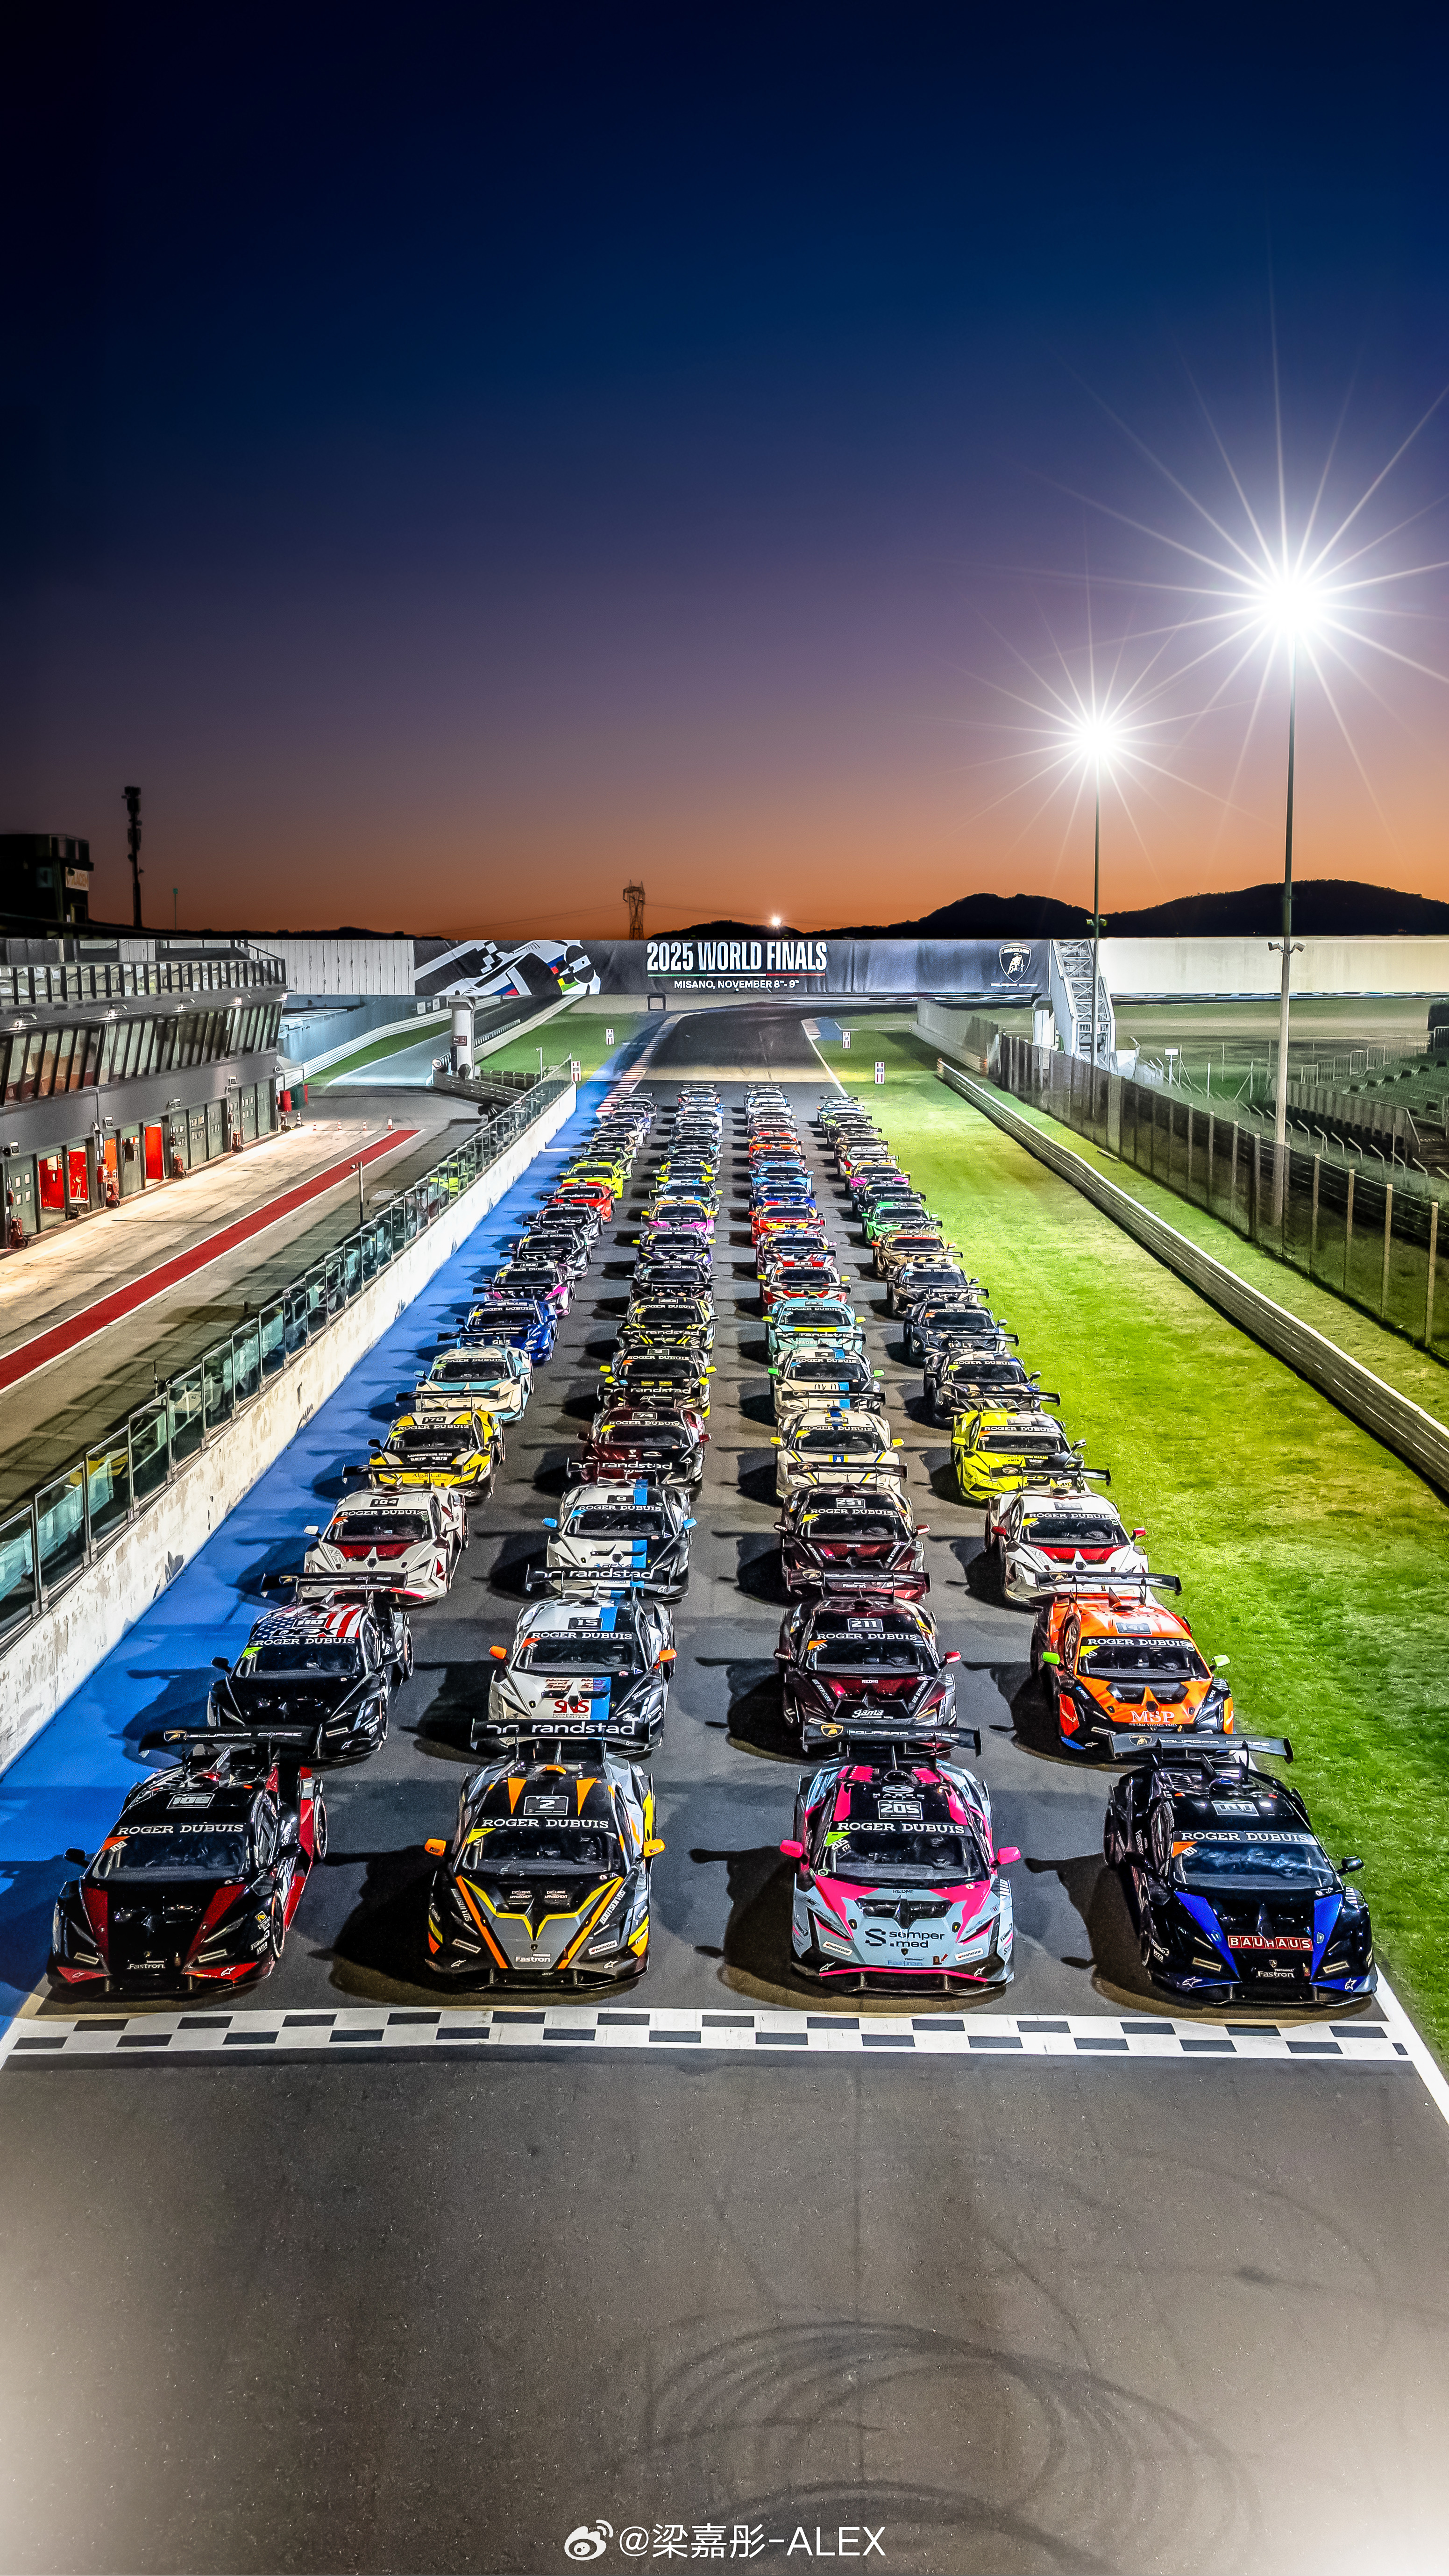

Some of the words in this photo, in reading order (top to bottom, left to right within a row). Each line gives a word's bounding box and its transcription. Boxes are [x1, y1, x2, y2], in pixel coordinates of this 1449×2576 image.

[647, 942, 693, 971] 2025
[697, 942, 762, 970] WORLD
[767, 941, 827, 970] FINALS
[674, 980, 715, 989] MISANO,
[569, 1568, 654, 1579] randstad
[1131, 1711, 1175, 1722] MSP
[532, 1721, 635, 1735] randstad
[539, 1800, 555, 1809] 2
[881, 1804, 920, 1814] 205
[117, 1825, 173, 1835] ROGER
[179, 1824, 244, 1833] DUBUIS
[482, 1819, 539, 1827] ROGER
[546, 1819, 608, 1829] DUBUIS
[838, 1822, 895, 1831] ROGER
[902, 1823, 965, 1834] DUBUIS
[1181, 1832, 1240, 1841] ROGER
[1247, 1832, 1309, 1843] DUBUIS
[1181, 1846, 1197, 1857] 101
[889, 1931, 945, 1940] semper
[1230, 1937, 1311, 1949] BAUHAUS
